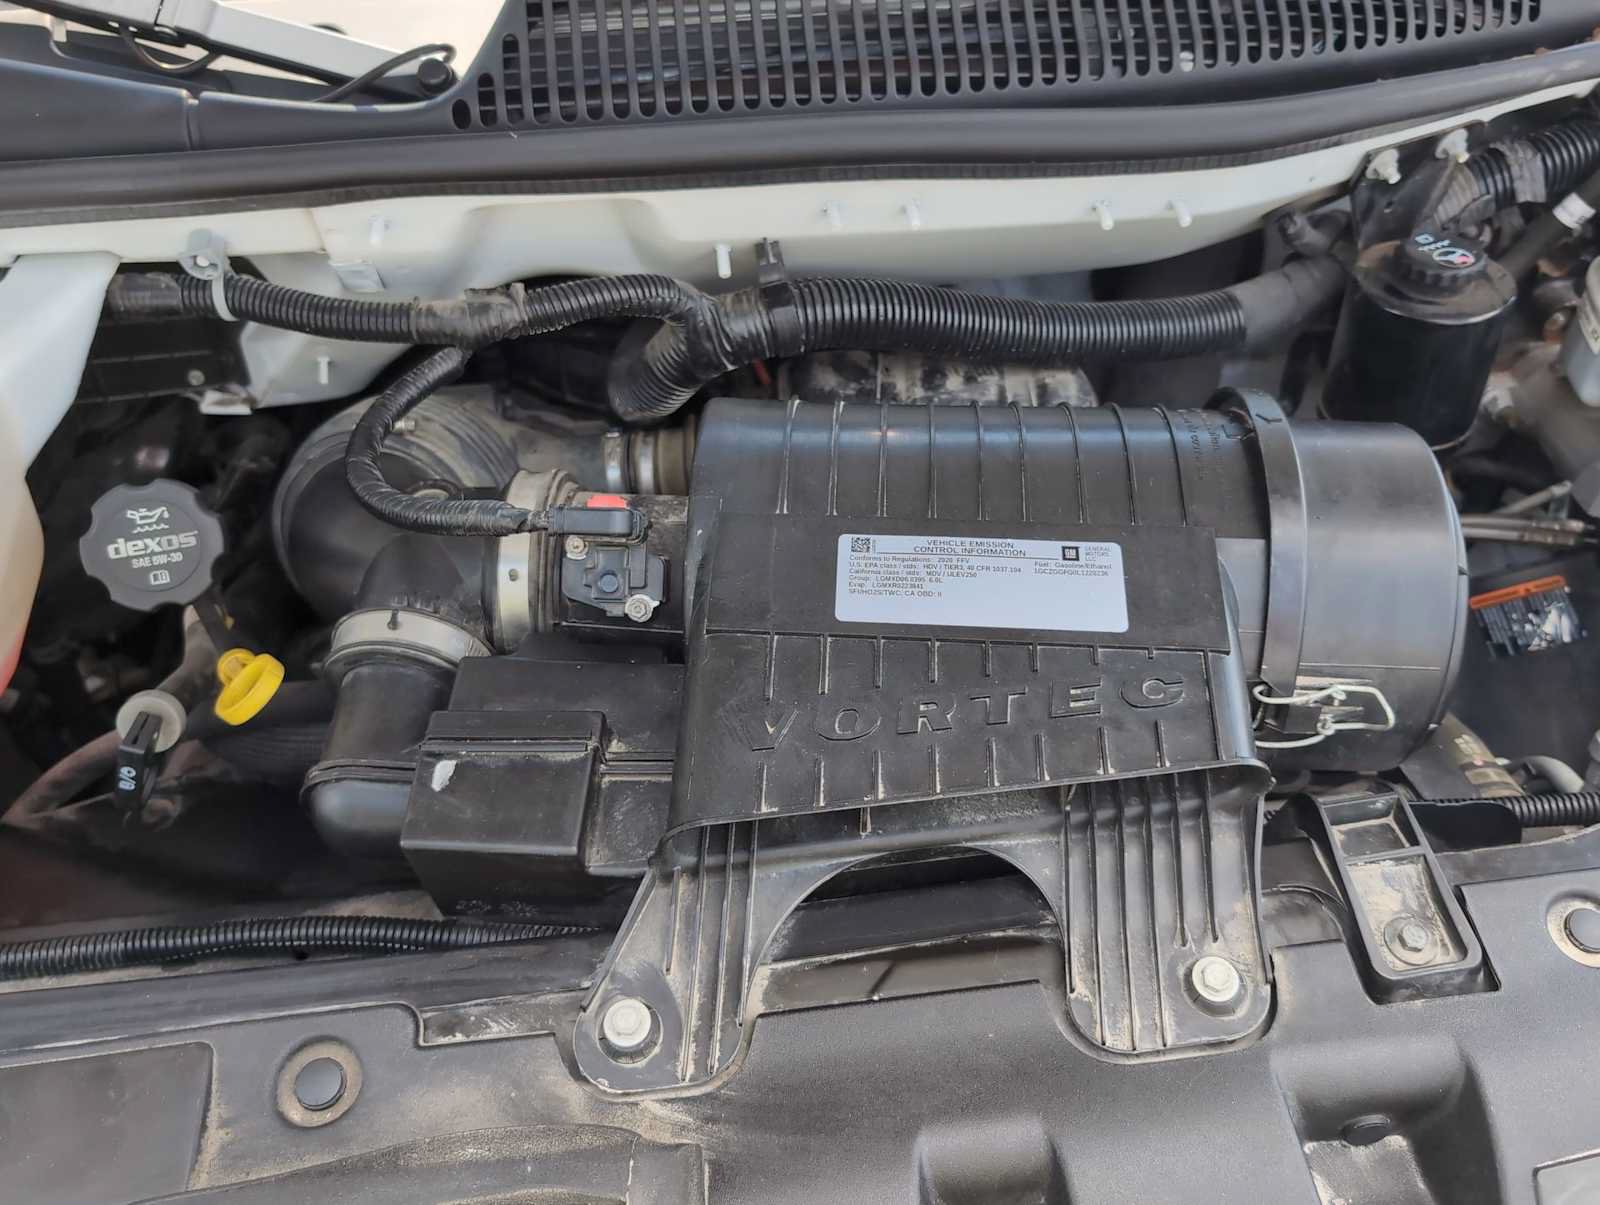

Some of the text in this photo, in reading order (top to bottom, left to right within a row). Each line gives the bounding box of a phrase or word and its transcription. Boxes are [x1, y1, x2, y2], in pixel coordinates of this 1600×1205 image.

[107, 530, 199, 560] dexos
[927, 539, 1014, 549] VEHICLE EMISSION
[913, 546, 1026, 557] CONTROL INFORMATION
[132, 557, 152, 569] SAE
[730, 676, 1187, 752] VORTEC
